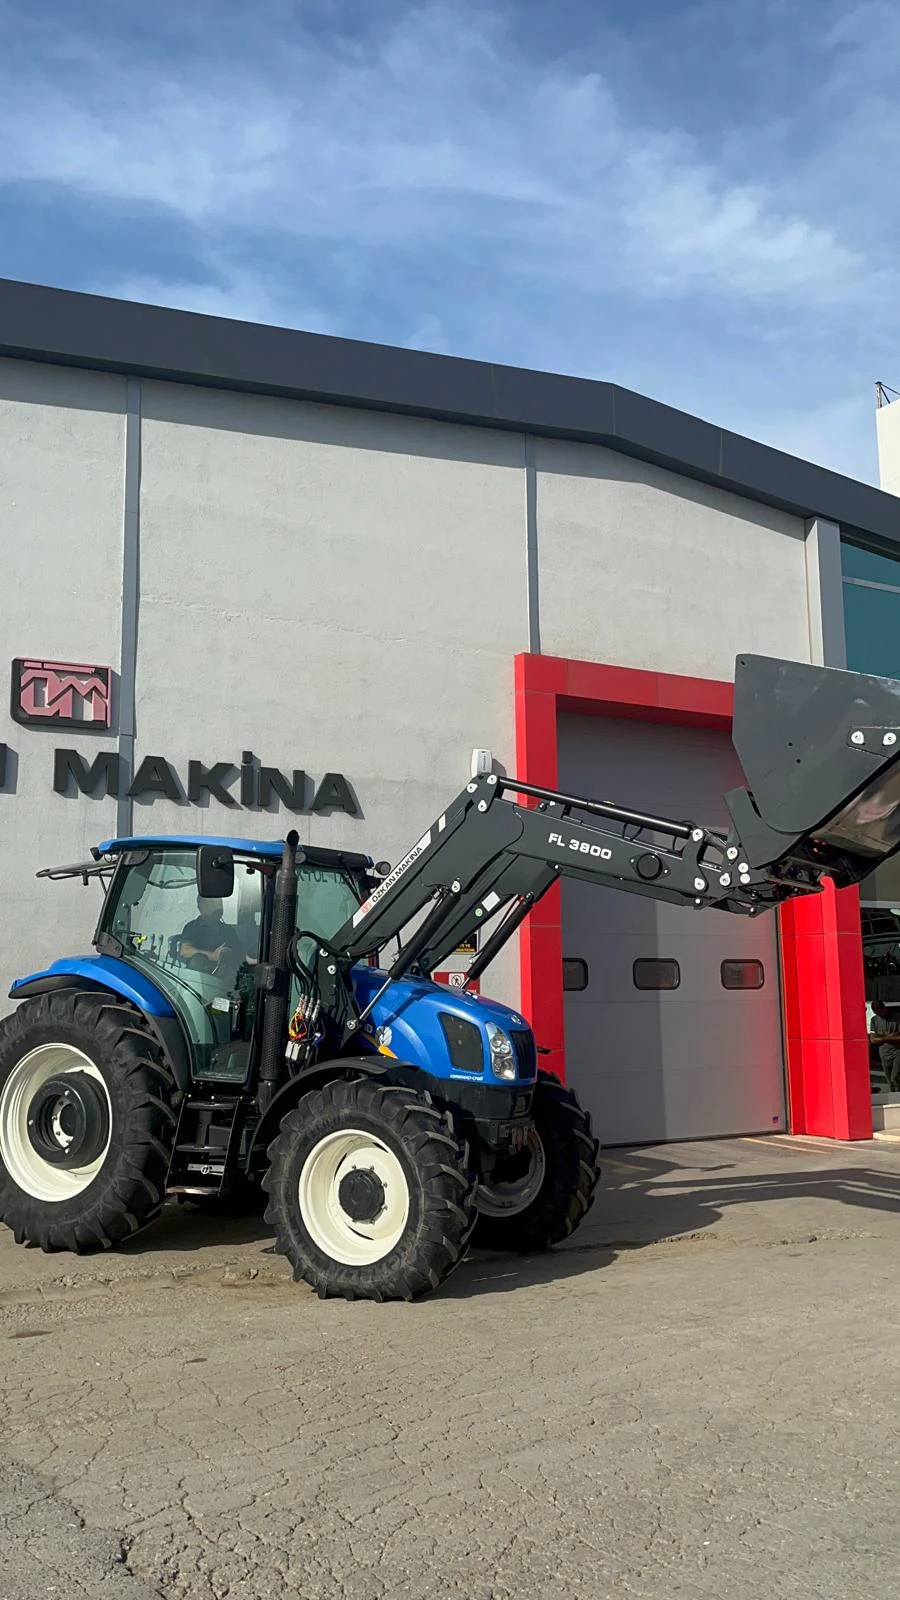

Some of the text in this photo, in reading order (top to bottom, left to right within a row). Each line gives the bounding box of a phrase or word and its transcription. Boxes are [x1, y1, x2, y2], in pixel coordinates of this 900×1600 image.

[53, 748, 358, 814] MAKİNA
[548, 832, 612, 860] FL 3800
